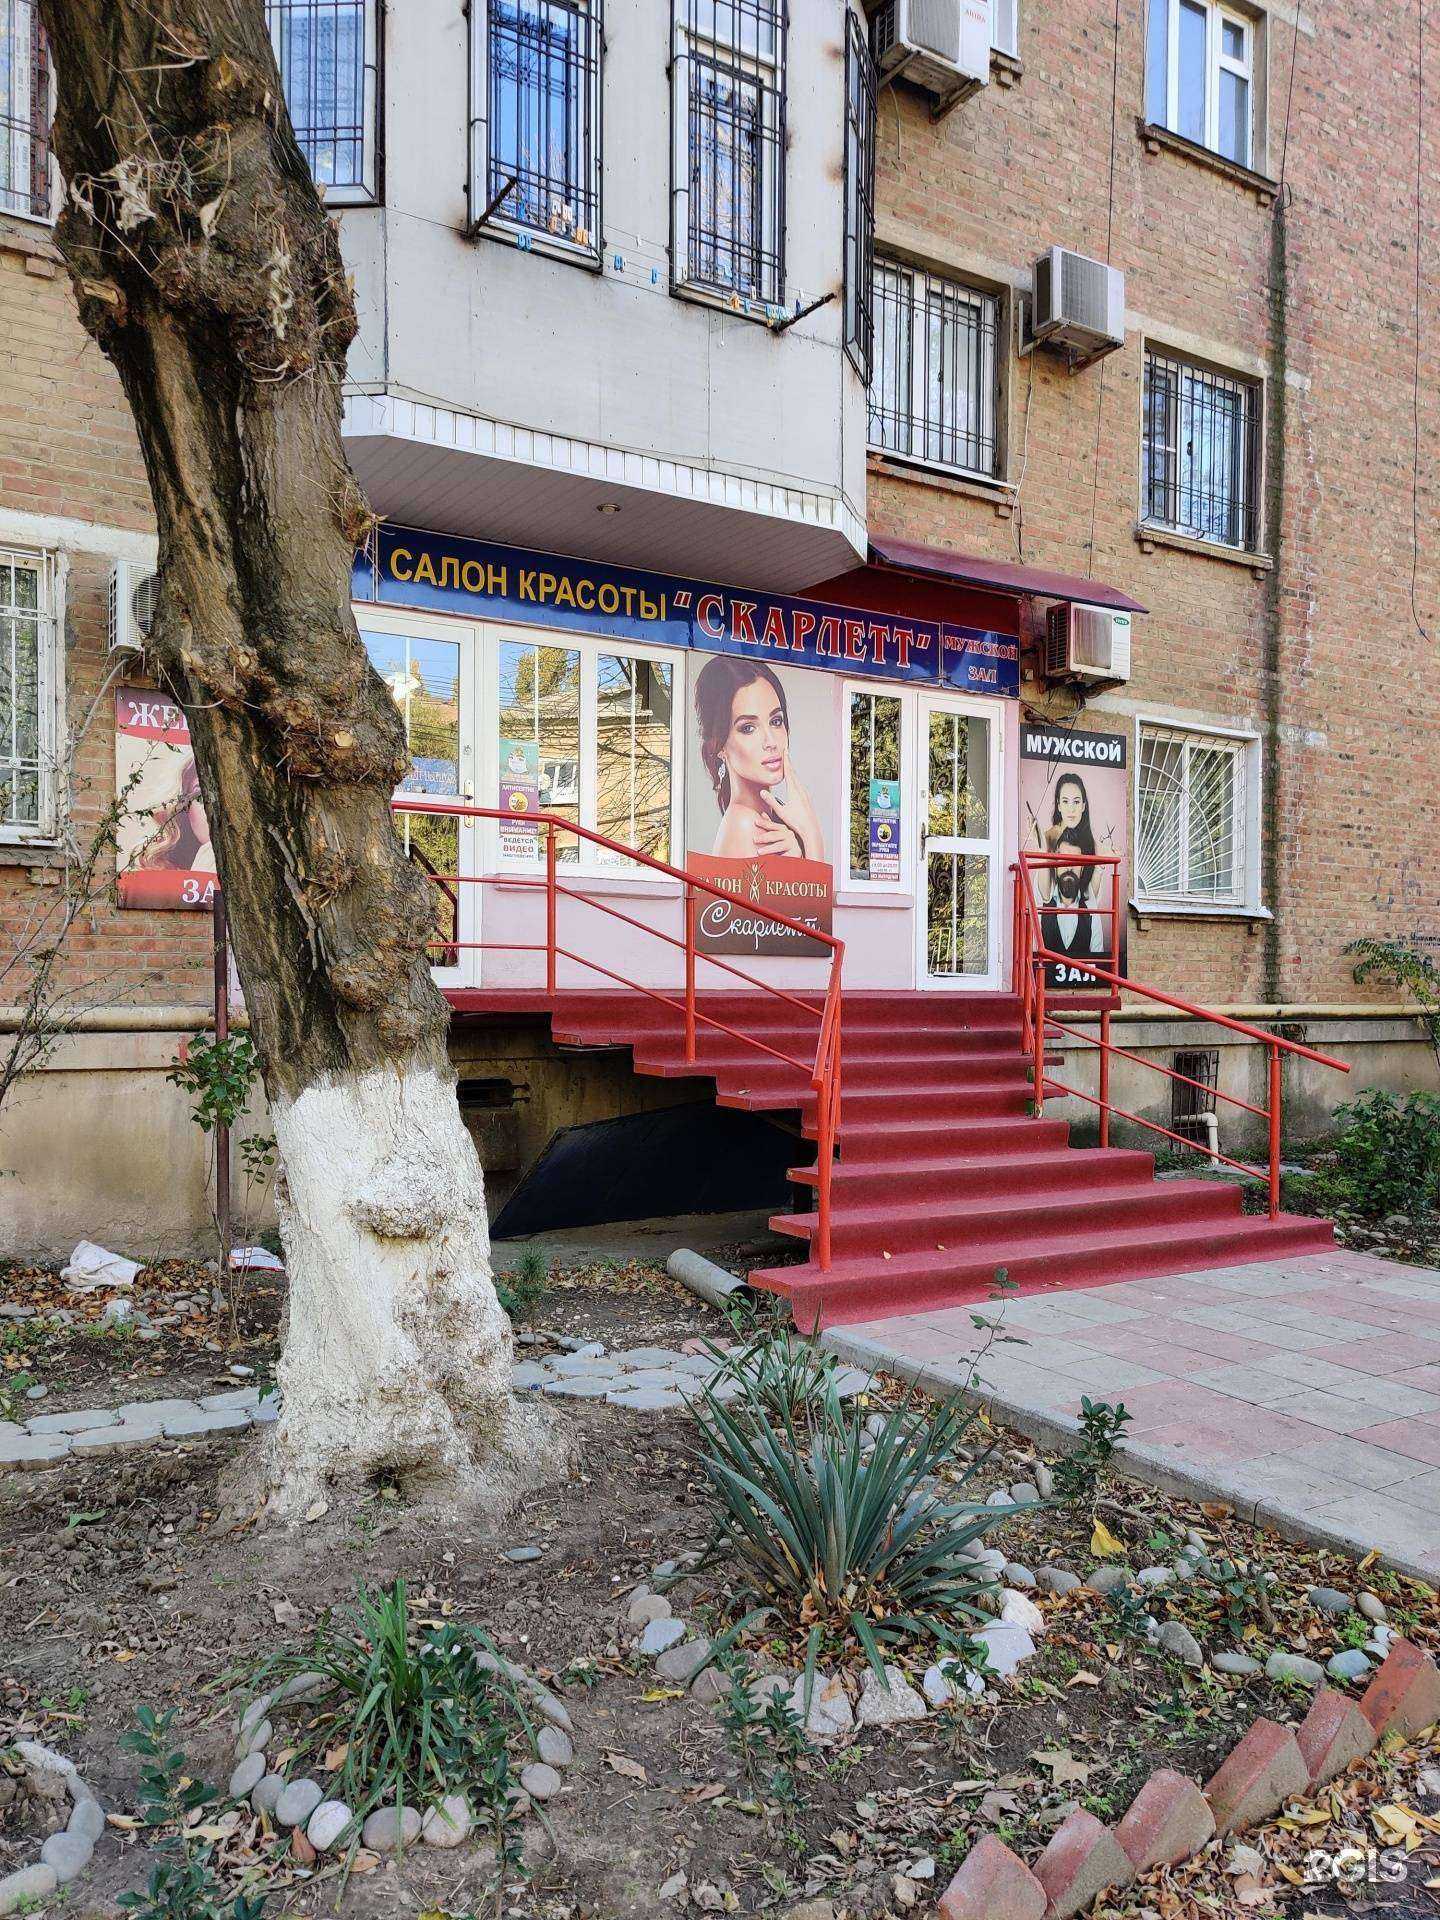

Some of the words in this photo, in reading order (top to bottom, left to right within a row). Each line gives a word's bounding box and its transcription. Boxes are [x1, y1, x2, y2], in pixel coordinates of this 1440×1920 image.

[390, 548, 507, 596] САЛОН
[519, 570, 666, 621] КРАСОТЫ
[674, 591, 931, 668] "СКАРЛЕТТ"
[944, 635, 1018, 660] МУЖСКОЙ
[968, 665, 997, 683] ЗАЛ
[1026, 733, 1121, 762] МУЖСКОЙ
[765, 880, 827, 898] КРАСОТЫ
